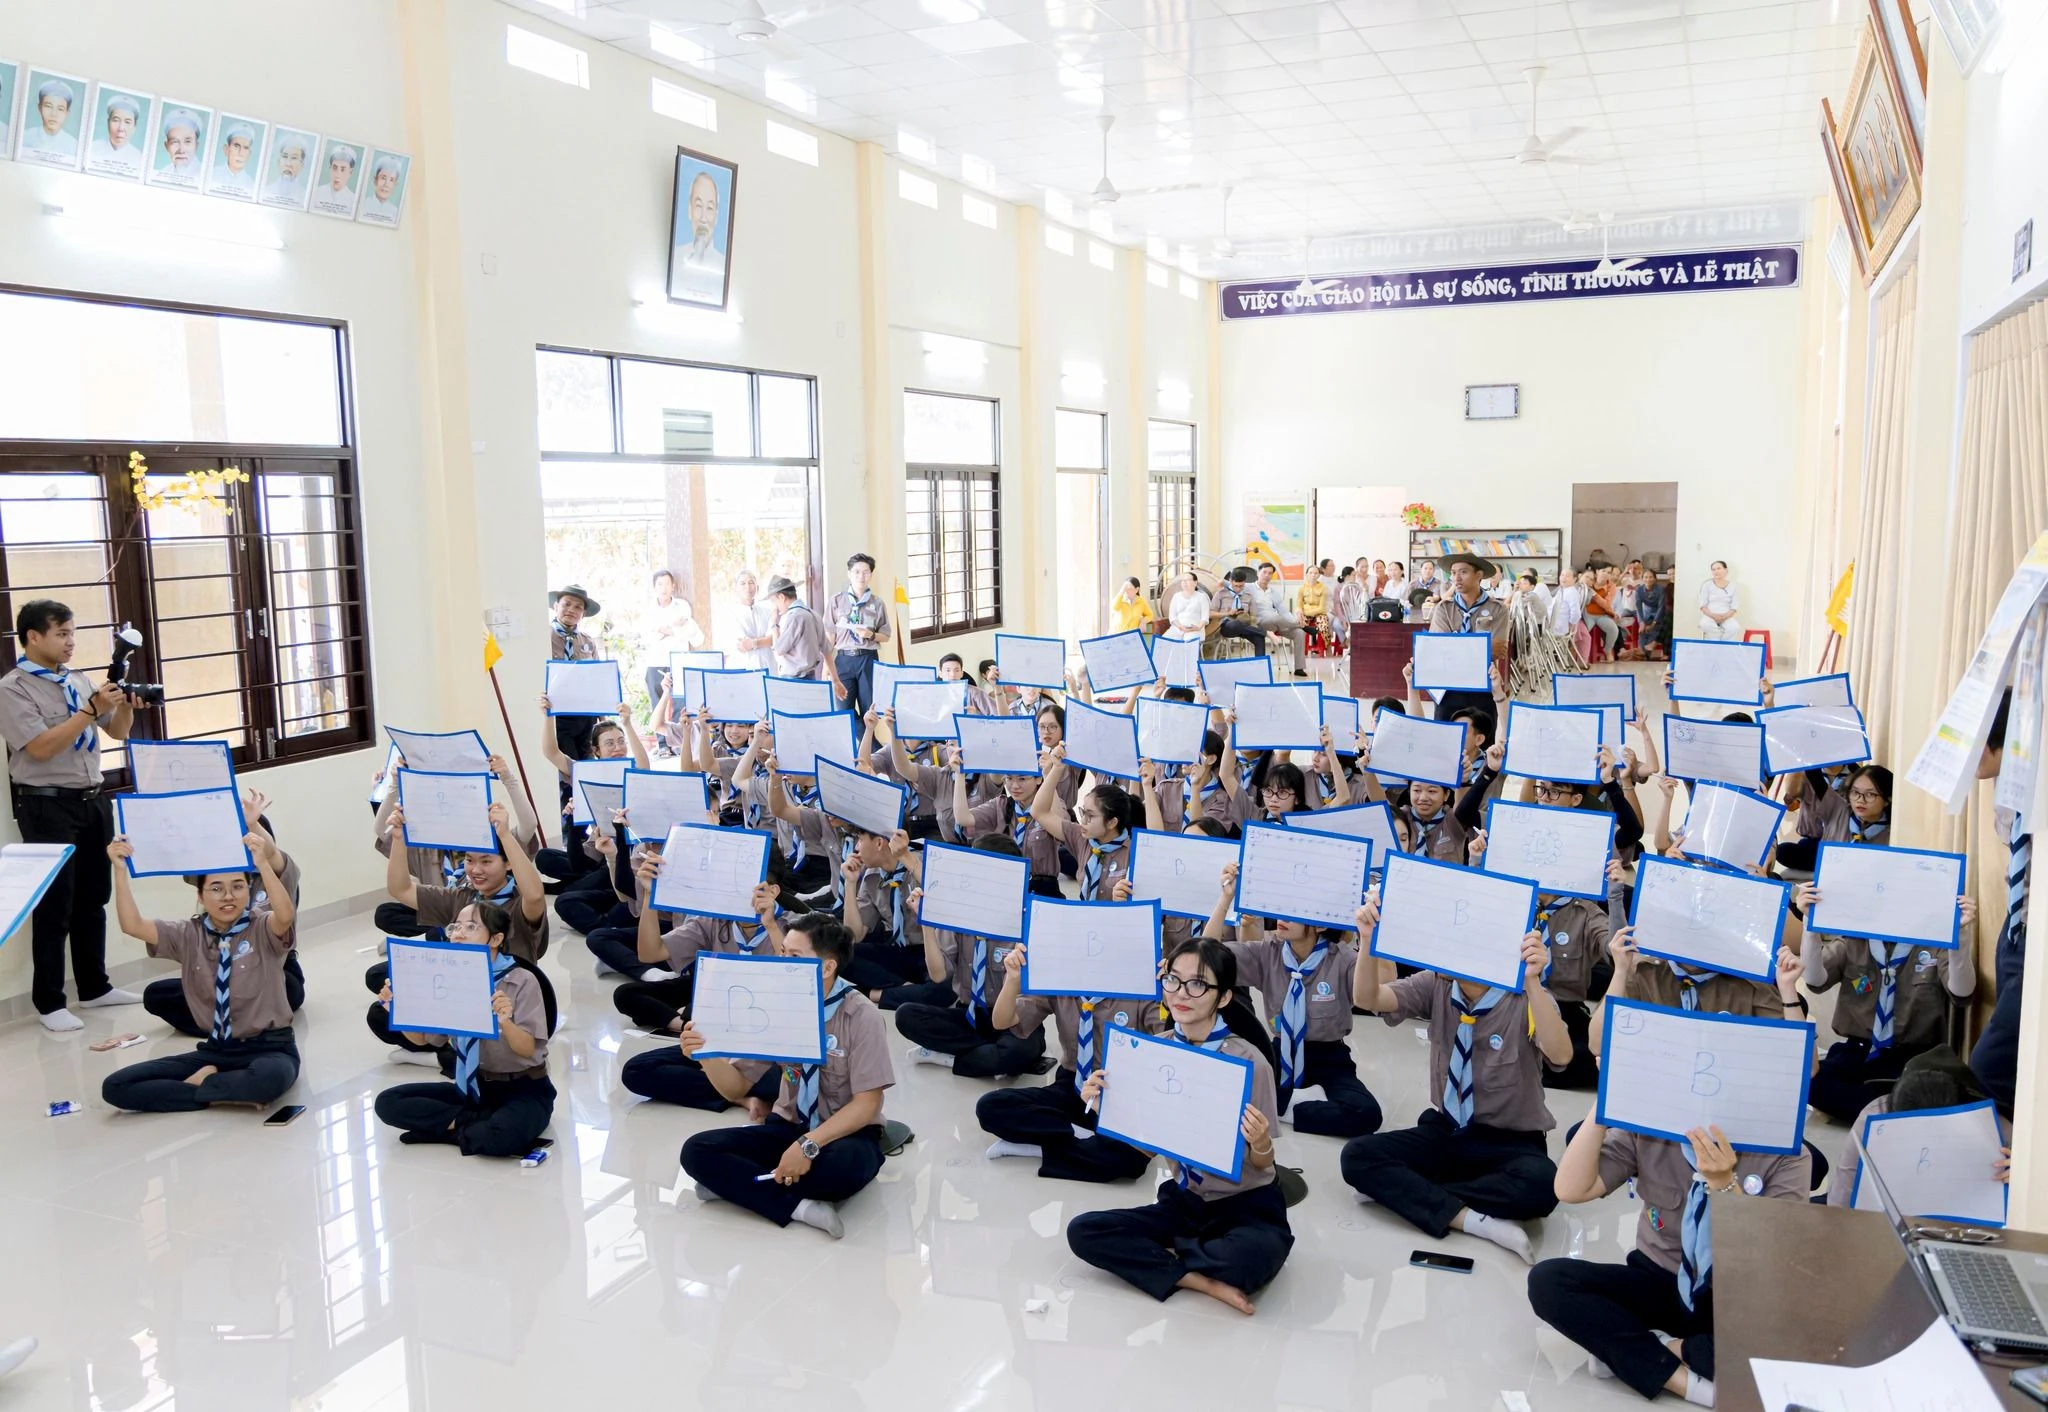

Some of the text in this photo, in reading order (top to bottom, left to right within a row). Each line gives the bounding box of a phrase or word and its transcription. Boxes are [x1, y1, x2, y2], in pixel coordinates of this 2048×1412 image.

[1238, 290, 1277, 313] VIỆC
[1321, 284, 1365, 305] GIÁO
[1369, 281, 1401, 305] HỘI
[1405, 279, 1429, 300] LÀ
[1432, 278, 1458, 303] SỰ
[1461, 272, 1517, 298] SỐNG,
[1658, 262, 1689, 284] VÀ
[1692, 260, 1719, 283] LẼ
[1722, 257, 1779, 284] THẬT
[1454, 898, 1470, 926] B
[1087, 930, 1105, 957] B
[726, 985, 769, 1034] B
[1153, 1064, 1184, 1095] B
[1691, 1050, 1721, 1096] B
